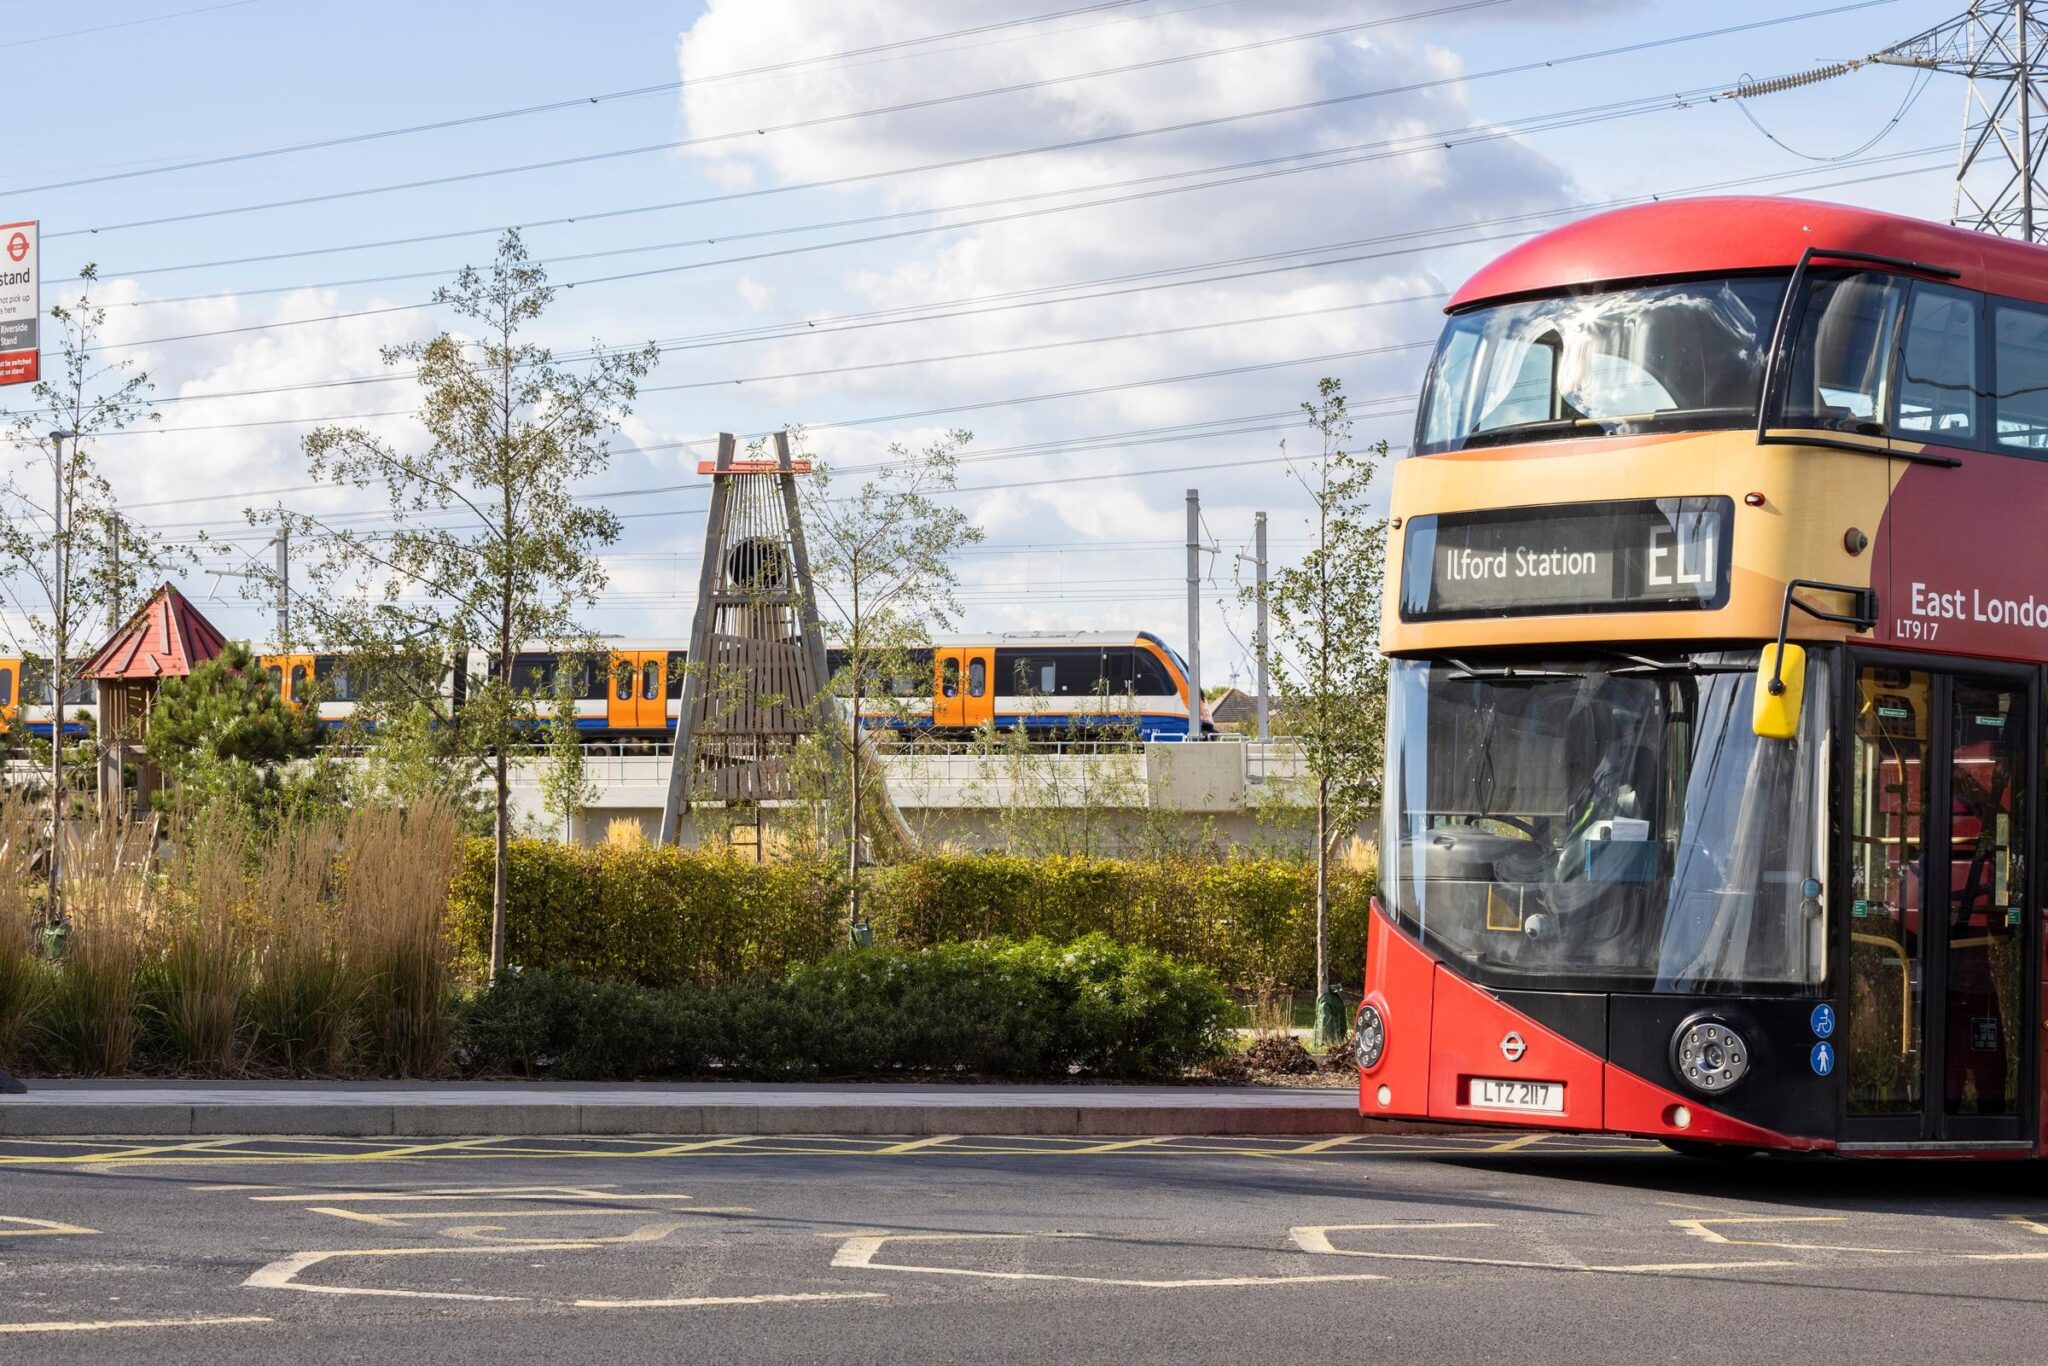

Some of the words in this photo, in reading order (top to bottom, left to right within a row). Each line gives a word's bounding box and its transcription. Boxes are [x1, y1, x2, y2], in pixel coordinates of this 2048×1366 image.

[0, 267, 30, 287] stand
[9, 294, 22, 304] pick
[22, 294, 31, 303] up
[4, 306, 16, 314] here
[0, 323, 28, 334] Riverside
[0, 335, 17, 346] Stand
[1447, 547, 1507, 580] Ilford
[1515, 546, 1596, 578] Station
[1911, 582, 1966, 620] East
[1974, 588, 2048, 628] Londo
[1896, 619, 1939, 641] LT917
[1484, 1082, 1514, 1104] LTZ
[1519, 1084, 1549, 1105] 2117
